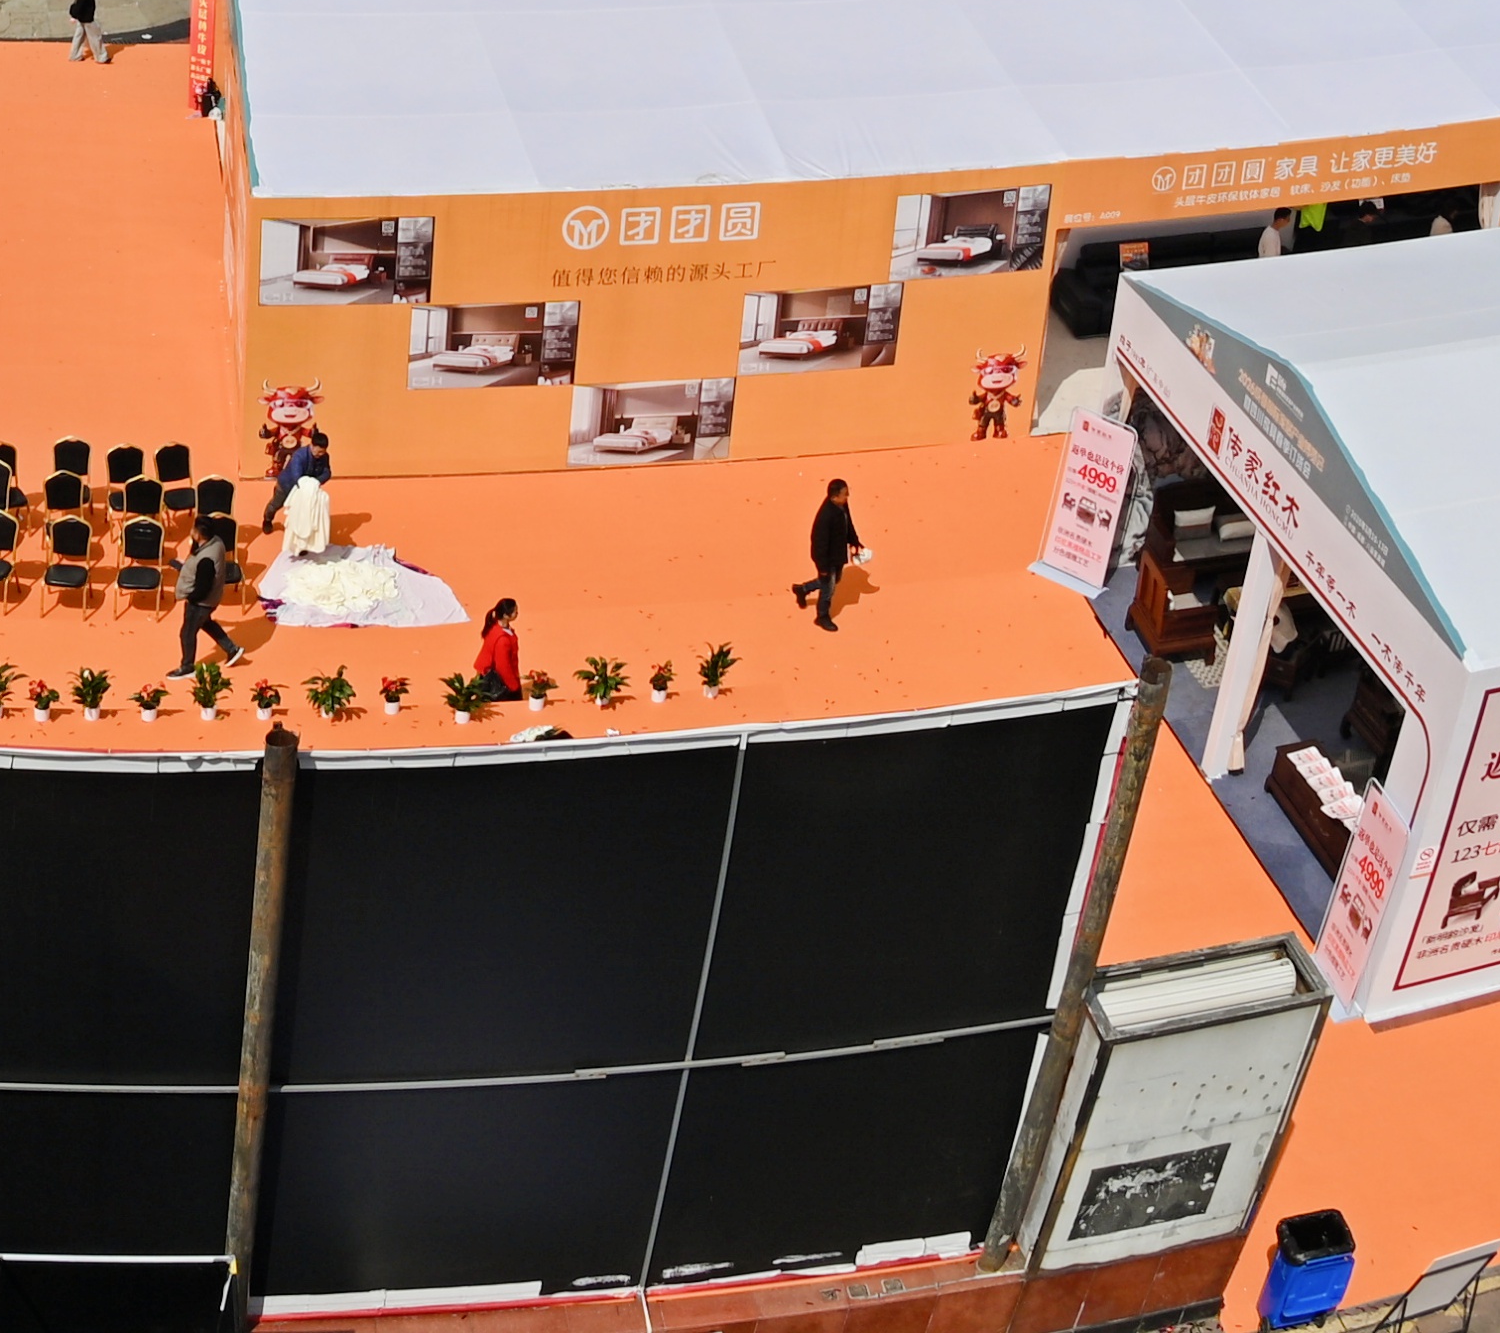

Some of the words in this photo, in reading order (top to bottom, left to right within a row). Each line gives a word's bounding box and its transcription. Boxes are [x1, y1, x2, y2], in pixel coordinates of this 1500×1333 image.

[1181, 158, 1266, 188] 团团圆
[1274, 153, 1318, 182] 家具
[1329, 140, 1438, 178] 让家更美好
[1171, 184, 1281, 210] 头层牛皮环保软体家居
[619, 200, 762, 247] 团团圆
[551, 257, 776, 289] 值得您信赖的源头工厂
[1071, 443, 1125, 477] 返单也是这个价
[1077, 463, 1118, 494] 4999
[1229, 426, 1300, 532] 传家红木
[1457, 814, 1500, 839] 仅需
[1359, 856, 1385, 899] 4999
